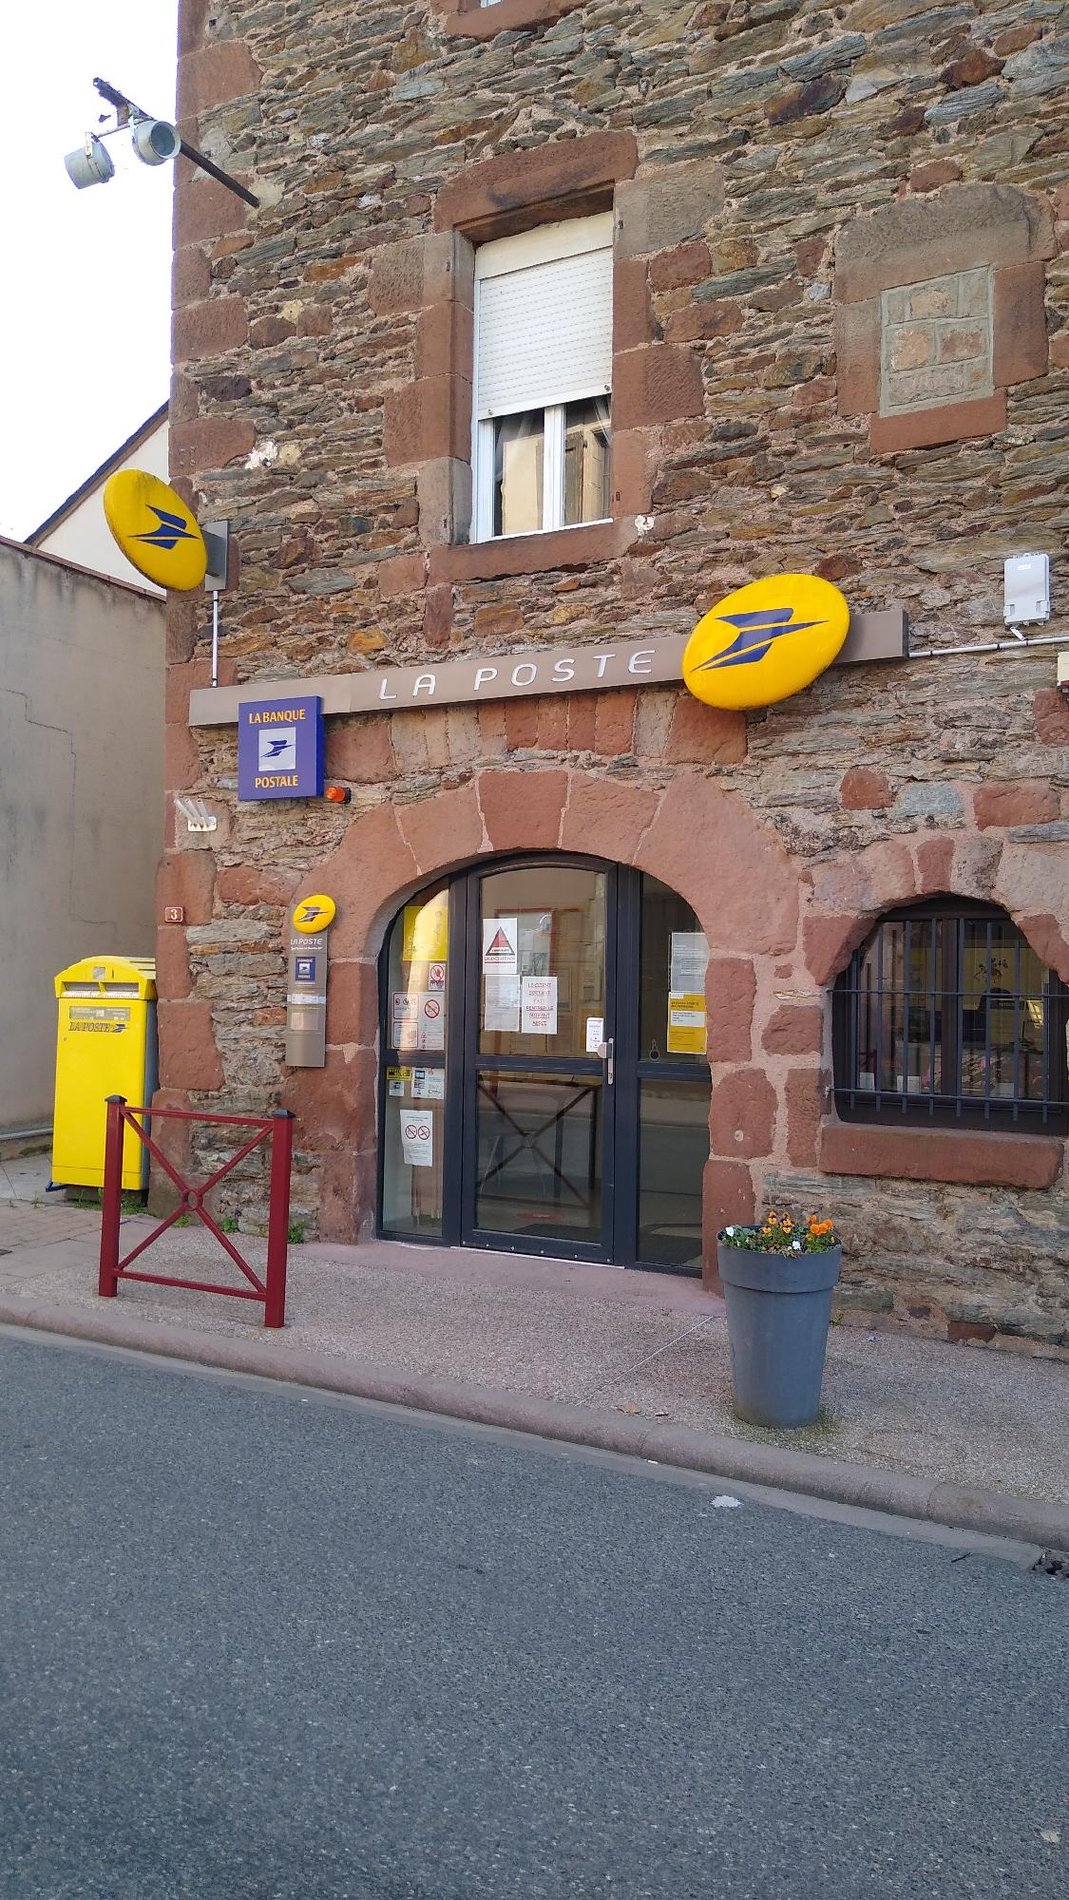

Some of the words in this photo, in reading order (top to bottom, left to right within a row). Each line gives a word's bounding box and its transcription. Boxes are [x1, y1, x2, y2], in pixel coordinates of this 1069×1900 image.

[378, 673, 436, 700] LA
[473, 649, 656, 691] POSTE
[248, 712, 261, 724] LA
[262, 708, 306, 723] BANQUE
[255, 775, 299, 789] POSTALE
[170, 908, 178, 920] 3
[68, 1021, 80, 1032] LA
[82, 1021, 111, 1033] POSTE
